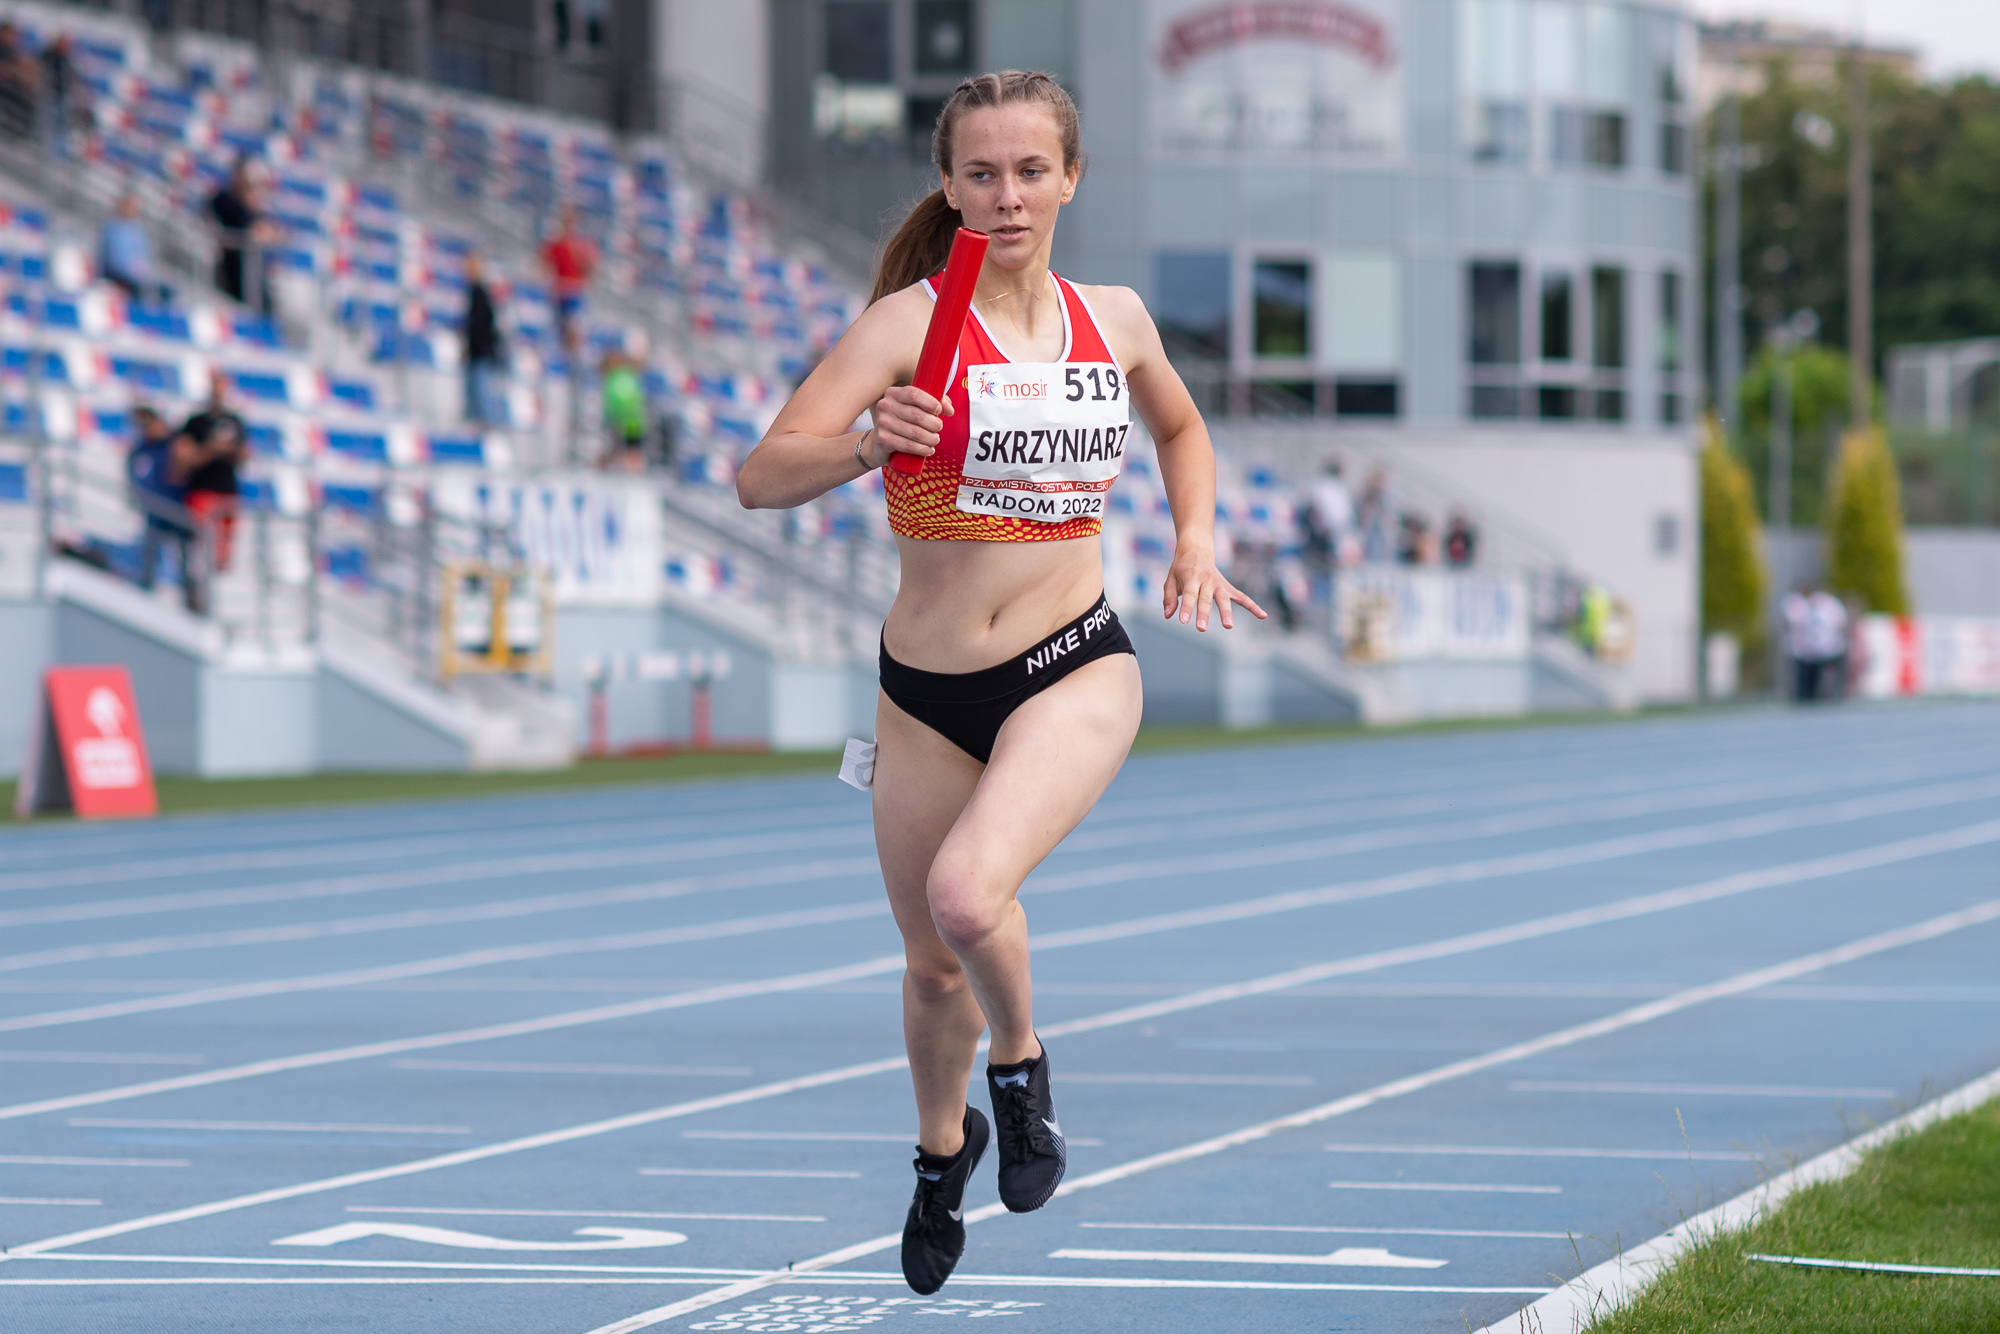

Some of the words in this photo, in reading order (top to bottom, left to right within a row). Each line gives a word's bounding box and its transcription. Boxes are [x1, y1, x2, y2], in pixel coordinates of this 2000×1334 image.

[1003, 379, 1047, 397] mosir
[1065, 367, 1120, 402] 519
[974, 424, 1129, 464] SKRZYNIARZ
[965, 478, 996, 488] PZLA
[997, 481, 1074, 493] MISTRZOSTWA
[972, 492, 1055, 514] RADOM
[1061, 498, 1101, 515] 2022
[1026, 627, 1080, 675] NIKE
[1083, 600, 1110, 640] PRO
